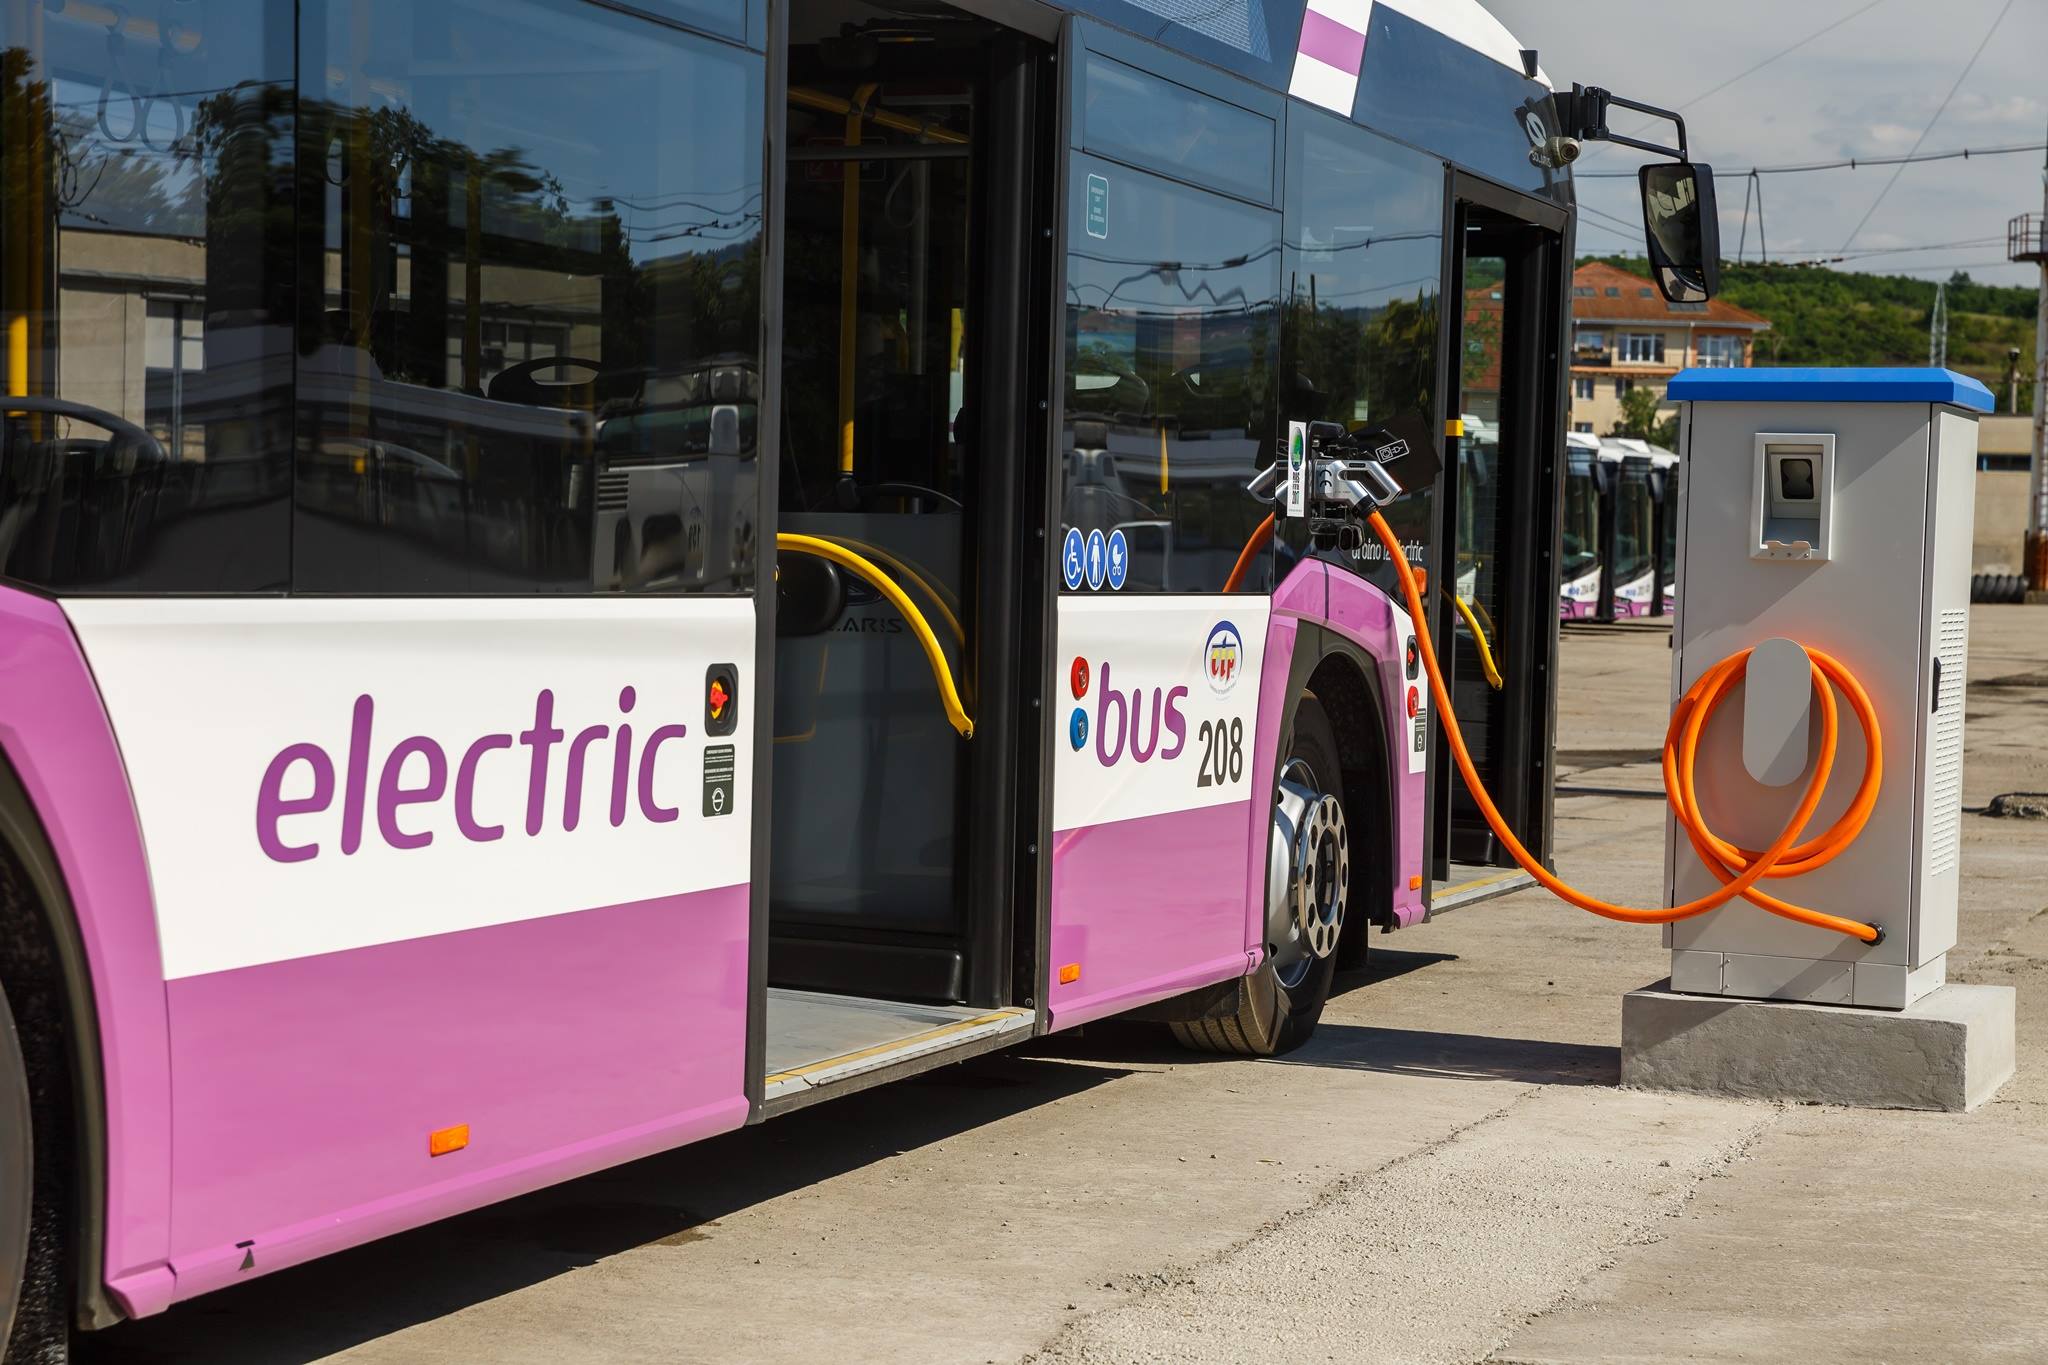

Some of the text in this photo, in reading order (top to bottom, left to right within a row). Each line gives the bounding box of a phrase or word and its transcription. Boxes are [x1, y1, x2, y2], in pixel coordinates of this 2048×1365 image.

[838, 617, 903, 633] ARIS
[1096, 661, 1188, 767] bus
[1197, 716, 1243, 788] 208
[256, 685, 687, 863] electric
